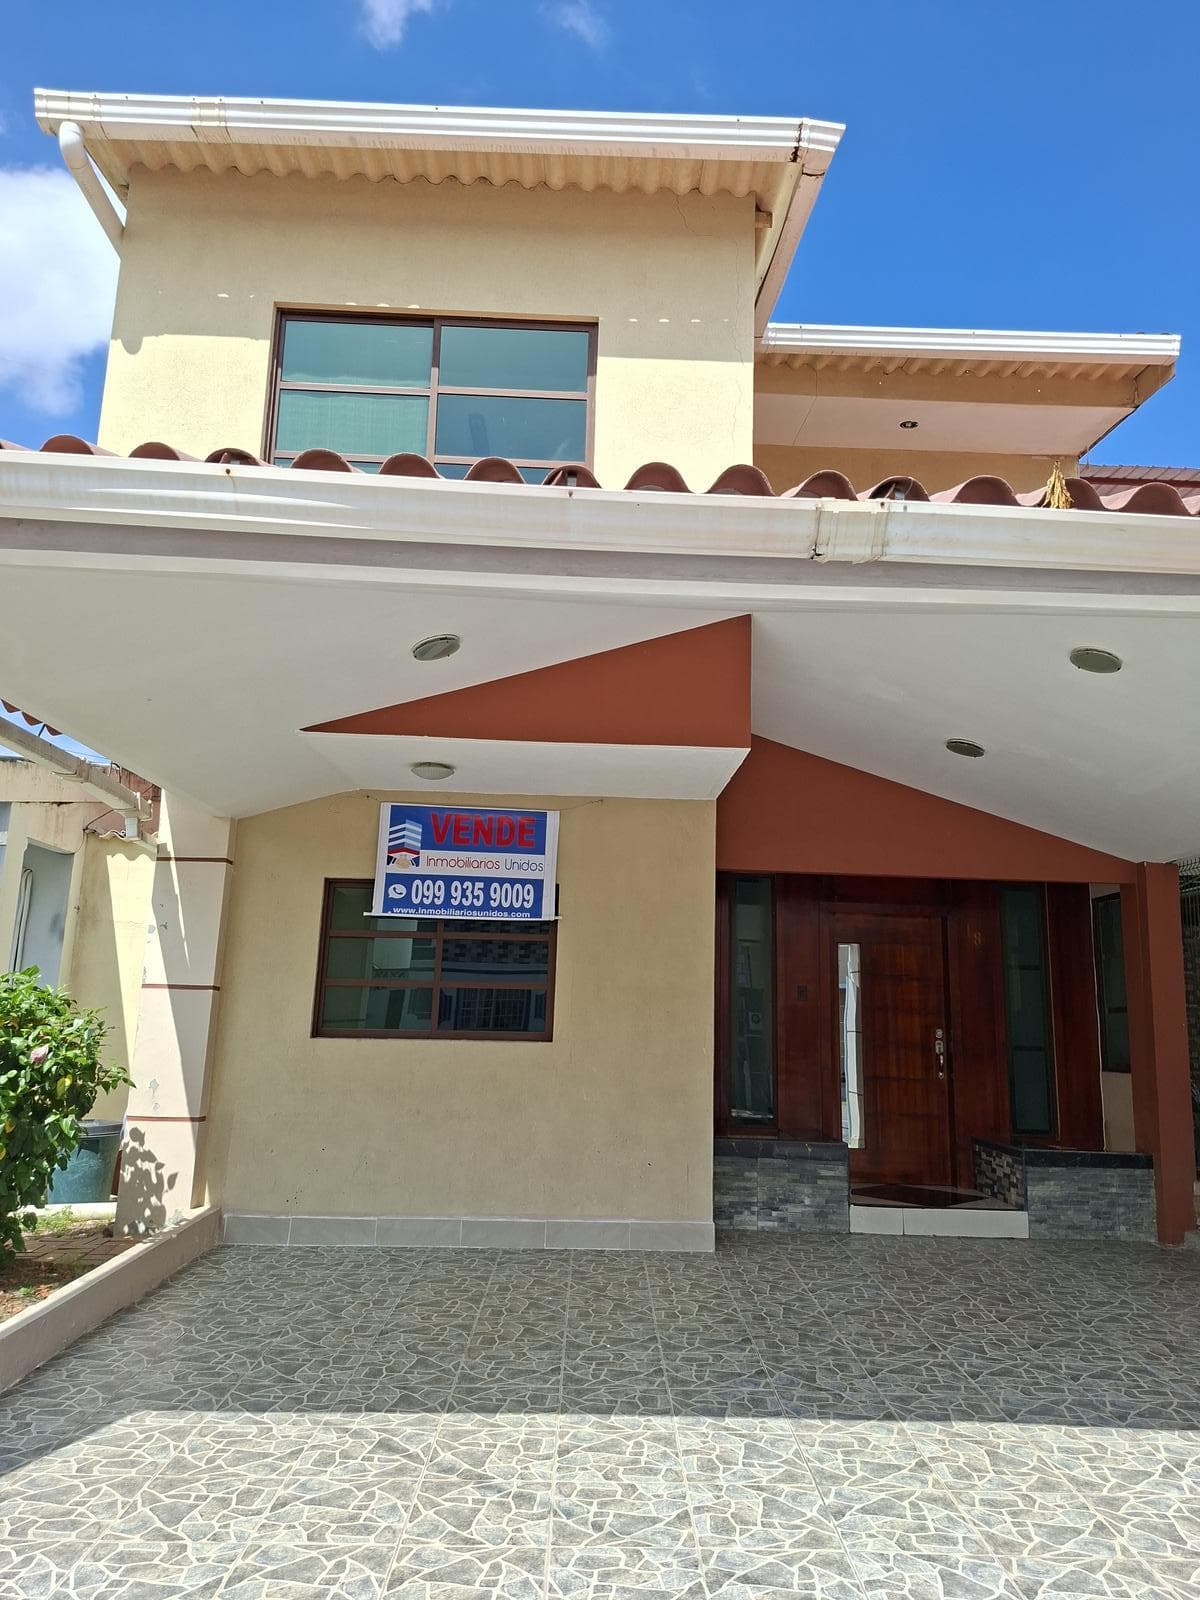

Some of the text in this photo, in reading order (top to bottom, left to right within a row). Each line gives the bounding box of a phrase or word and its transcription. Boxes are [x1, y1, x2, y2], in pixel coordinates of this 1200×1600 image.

[431, 812, 536, 848] VENDE
[426, 855, 544, 872] Inmobiliarios Unidos
[411, 879, 534, 909] 099 935 9009
[393, 906, 531, 918] www.inmobiliariosunidos.com
